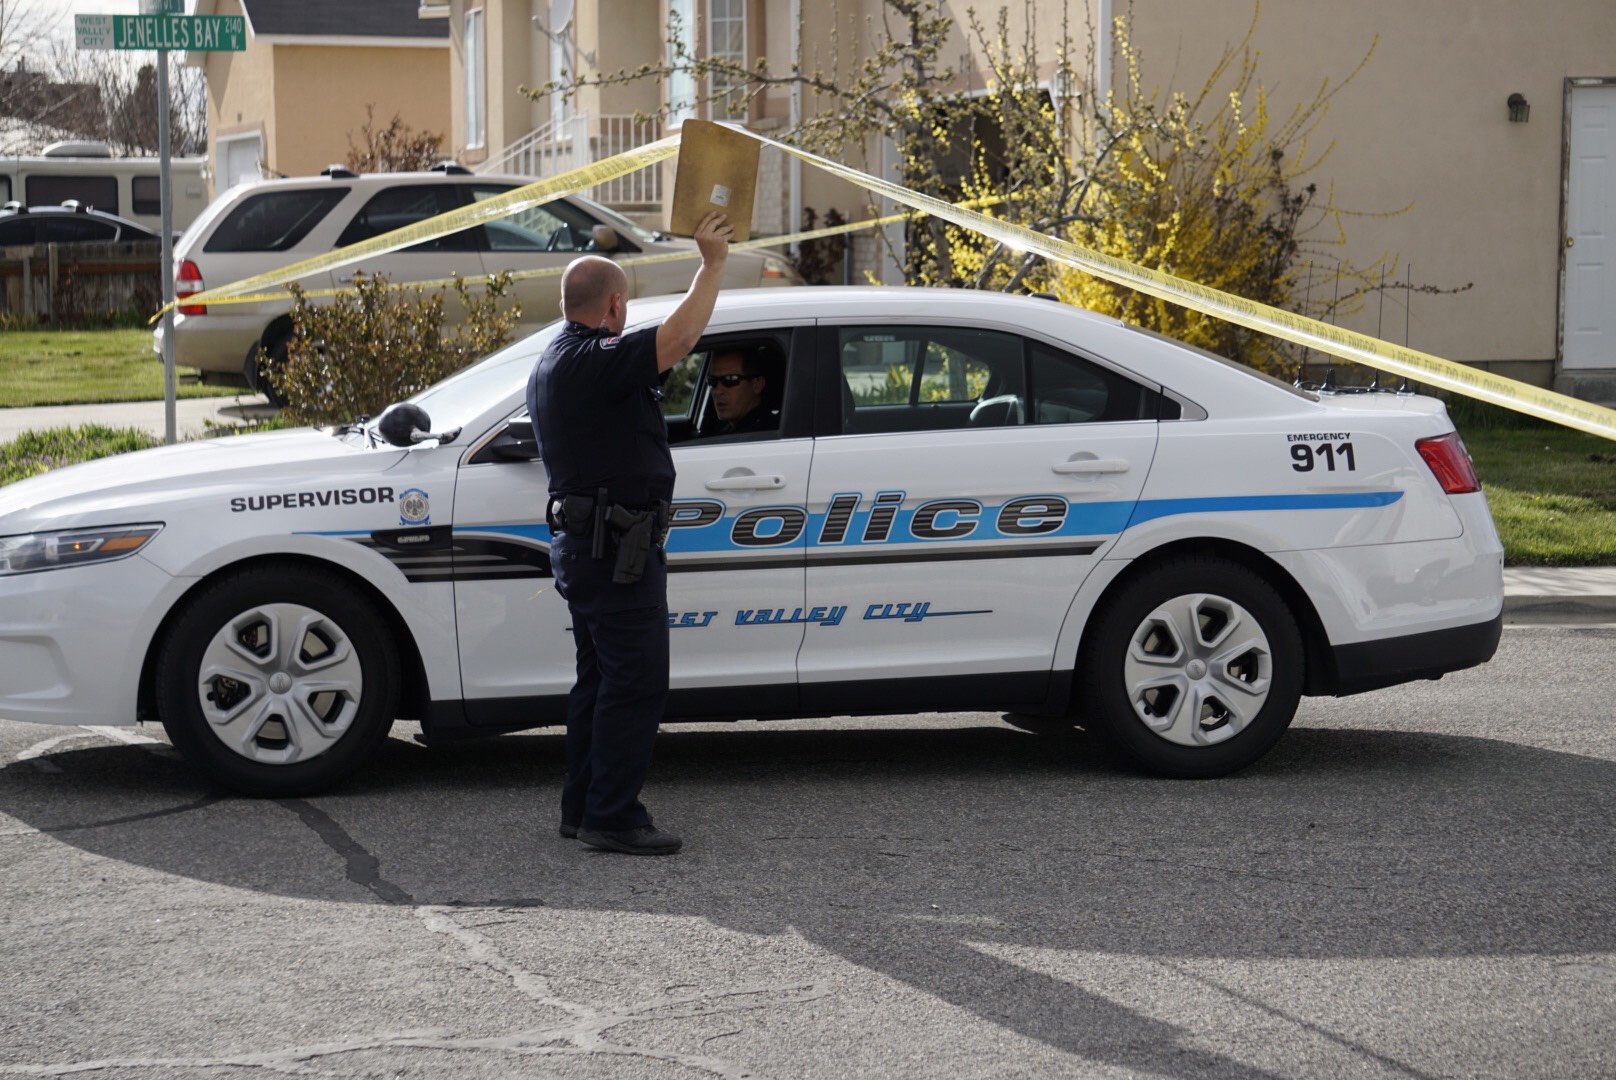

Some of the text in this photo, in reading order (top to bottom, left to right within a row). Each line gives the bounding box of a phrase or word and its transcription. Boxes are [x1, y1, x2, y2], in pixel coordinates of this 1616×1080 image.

[79, 16, 107, 25] WEST
[76, 27, 111, 35] VALLEY
[119, 17, 220, 48] JENELLES BAY
[83, 36, 105, 46] CITY
[1286, 432, 1351, 442] EMERGENCY
[1290, 442, 1356, 472] 911
[230, 486, 395, 513] SUPERVISOR
[664, 491, 1069, 549] Police
[668, 611, 719, 628] EST
